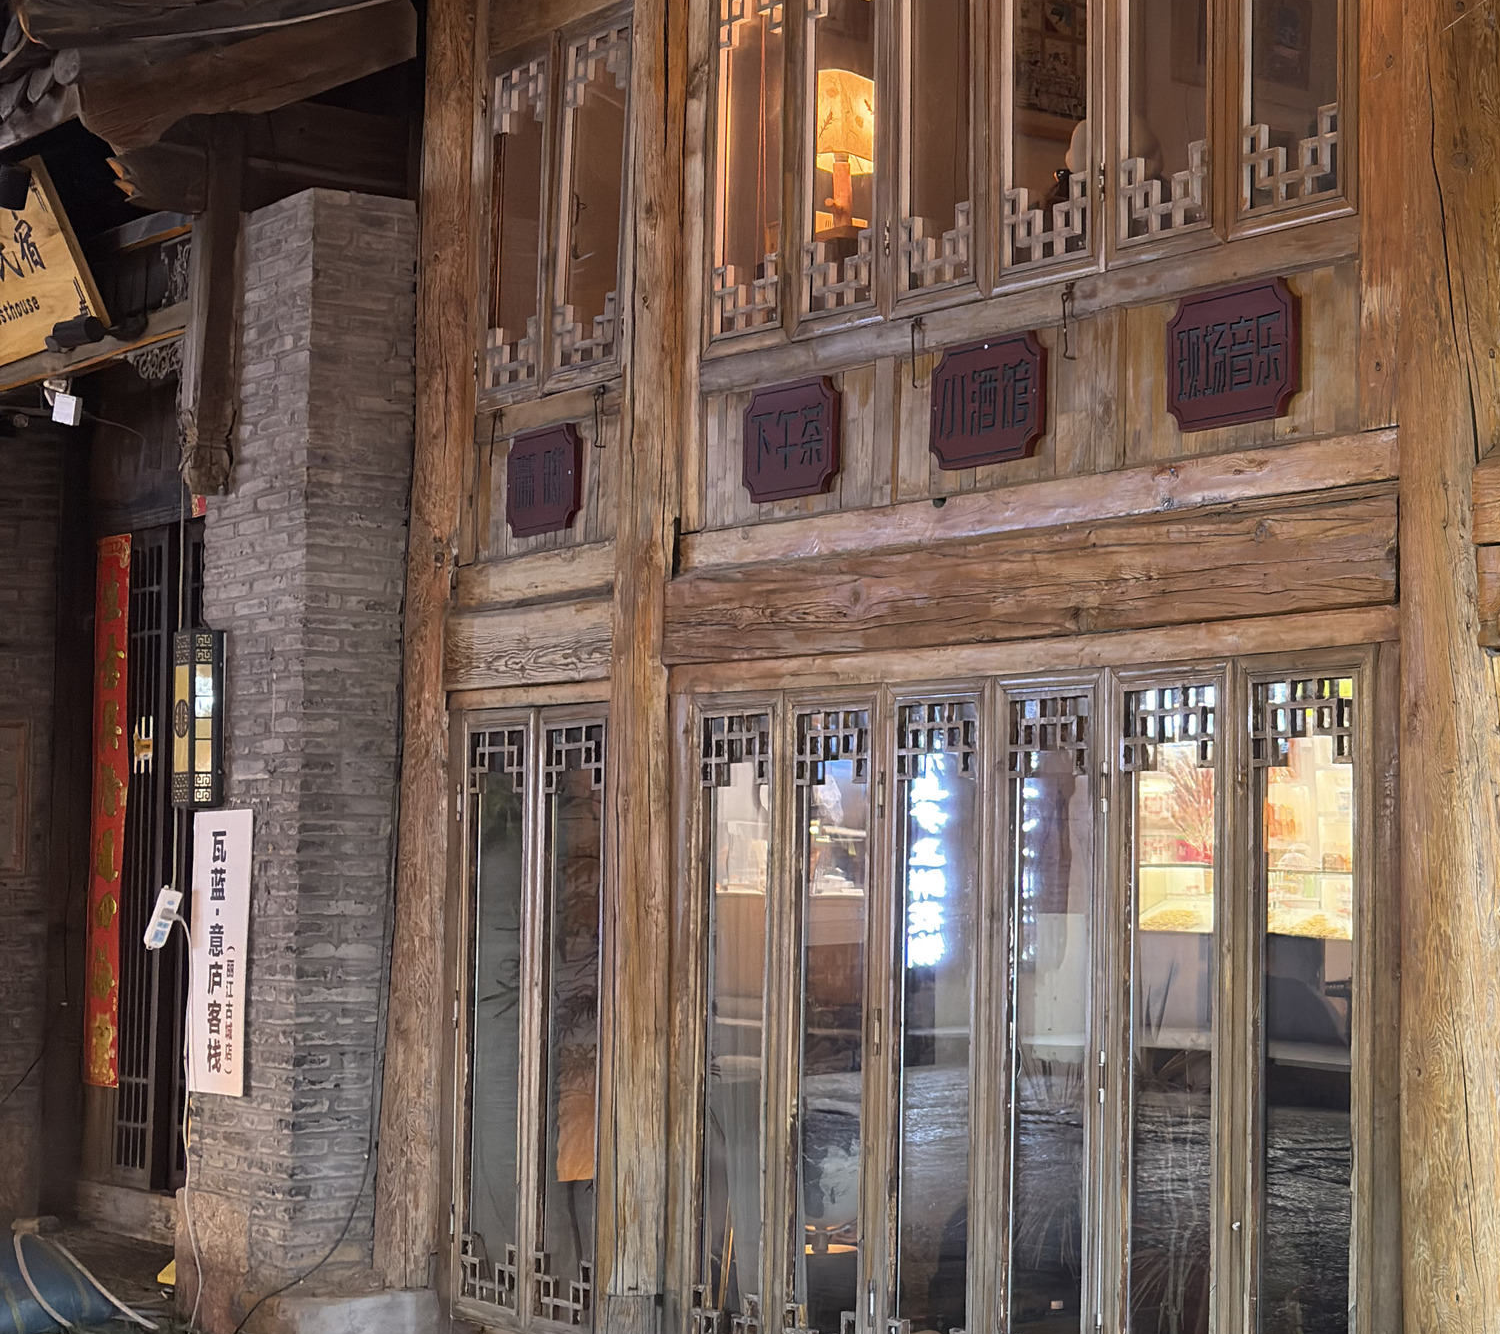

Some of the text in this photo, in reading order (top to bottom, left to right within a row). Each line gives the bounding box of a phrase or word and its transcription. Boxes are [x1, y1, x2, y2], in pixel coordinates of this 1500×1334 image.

[1177, 310, 1282, 402] 现场音乐
[751, 402, 824, 474] 下午茶
[939, 358, 1031, 441] 小酒馆
